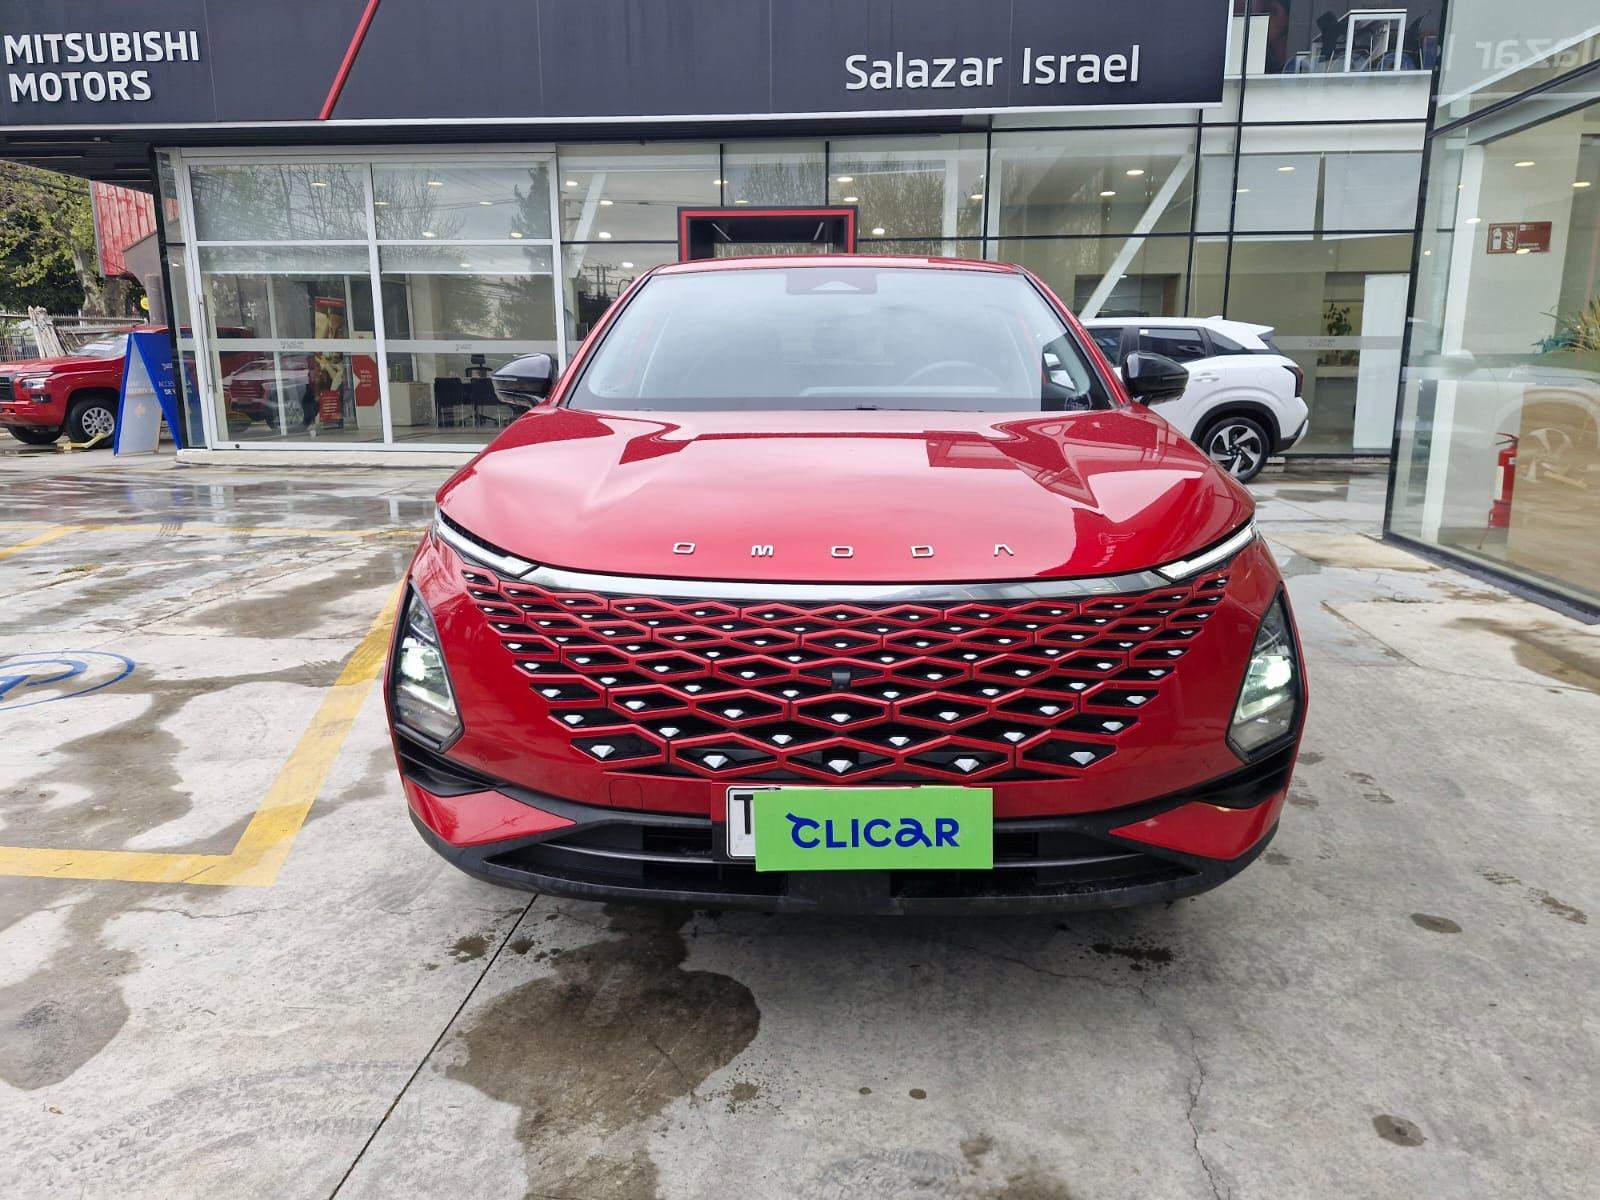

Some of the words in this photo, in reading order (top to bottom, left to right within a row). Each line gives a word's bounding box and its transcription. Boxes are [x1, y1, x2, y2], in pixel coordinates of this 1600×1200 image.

[4, 30, 200, 65] MITSUBISHI
[845, 51, 1003, 90] Salazar
[1022, 44, 1140, 85] Israel
[8, 69, 153, 103] MOTORS
